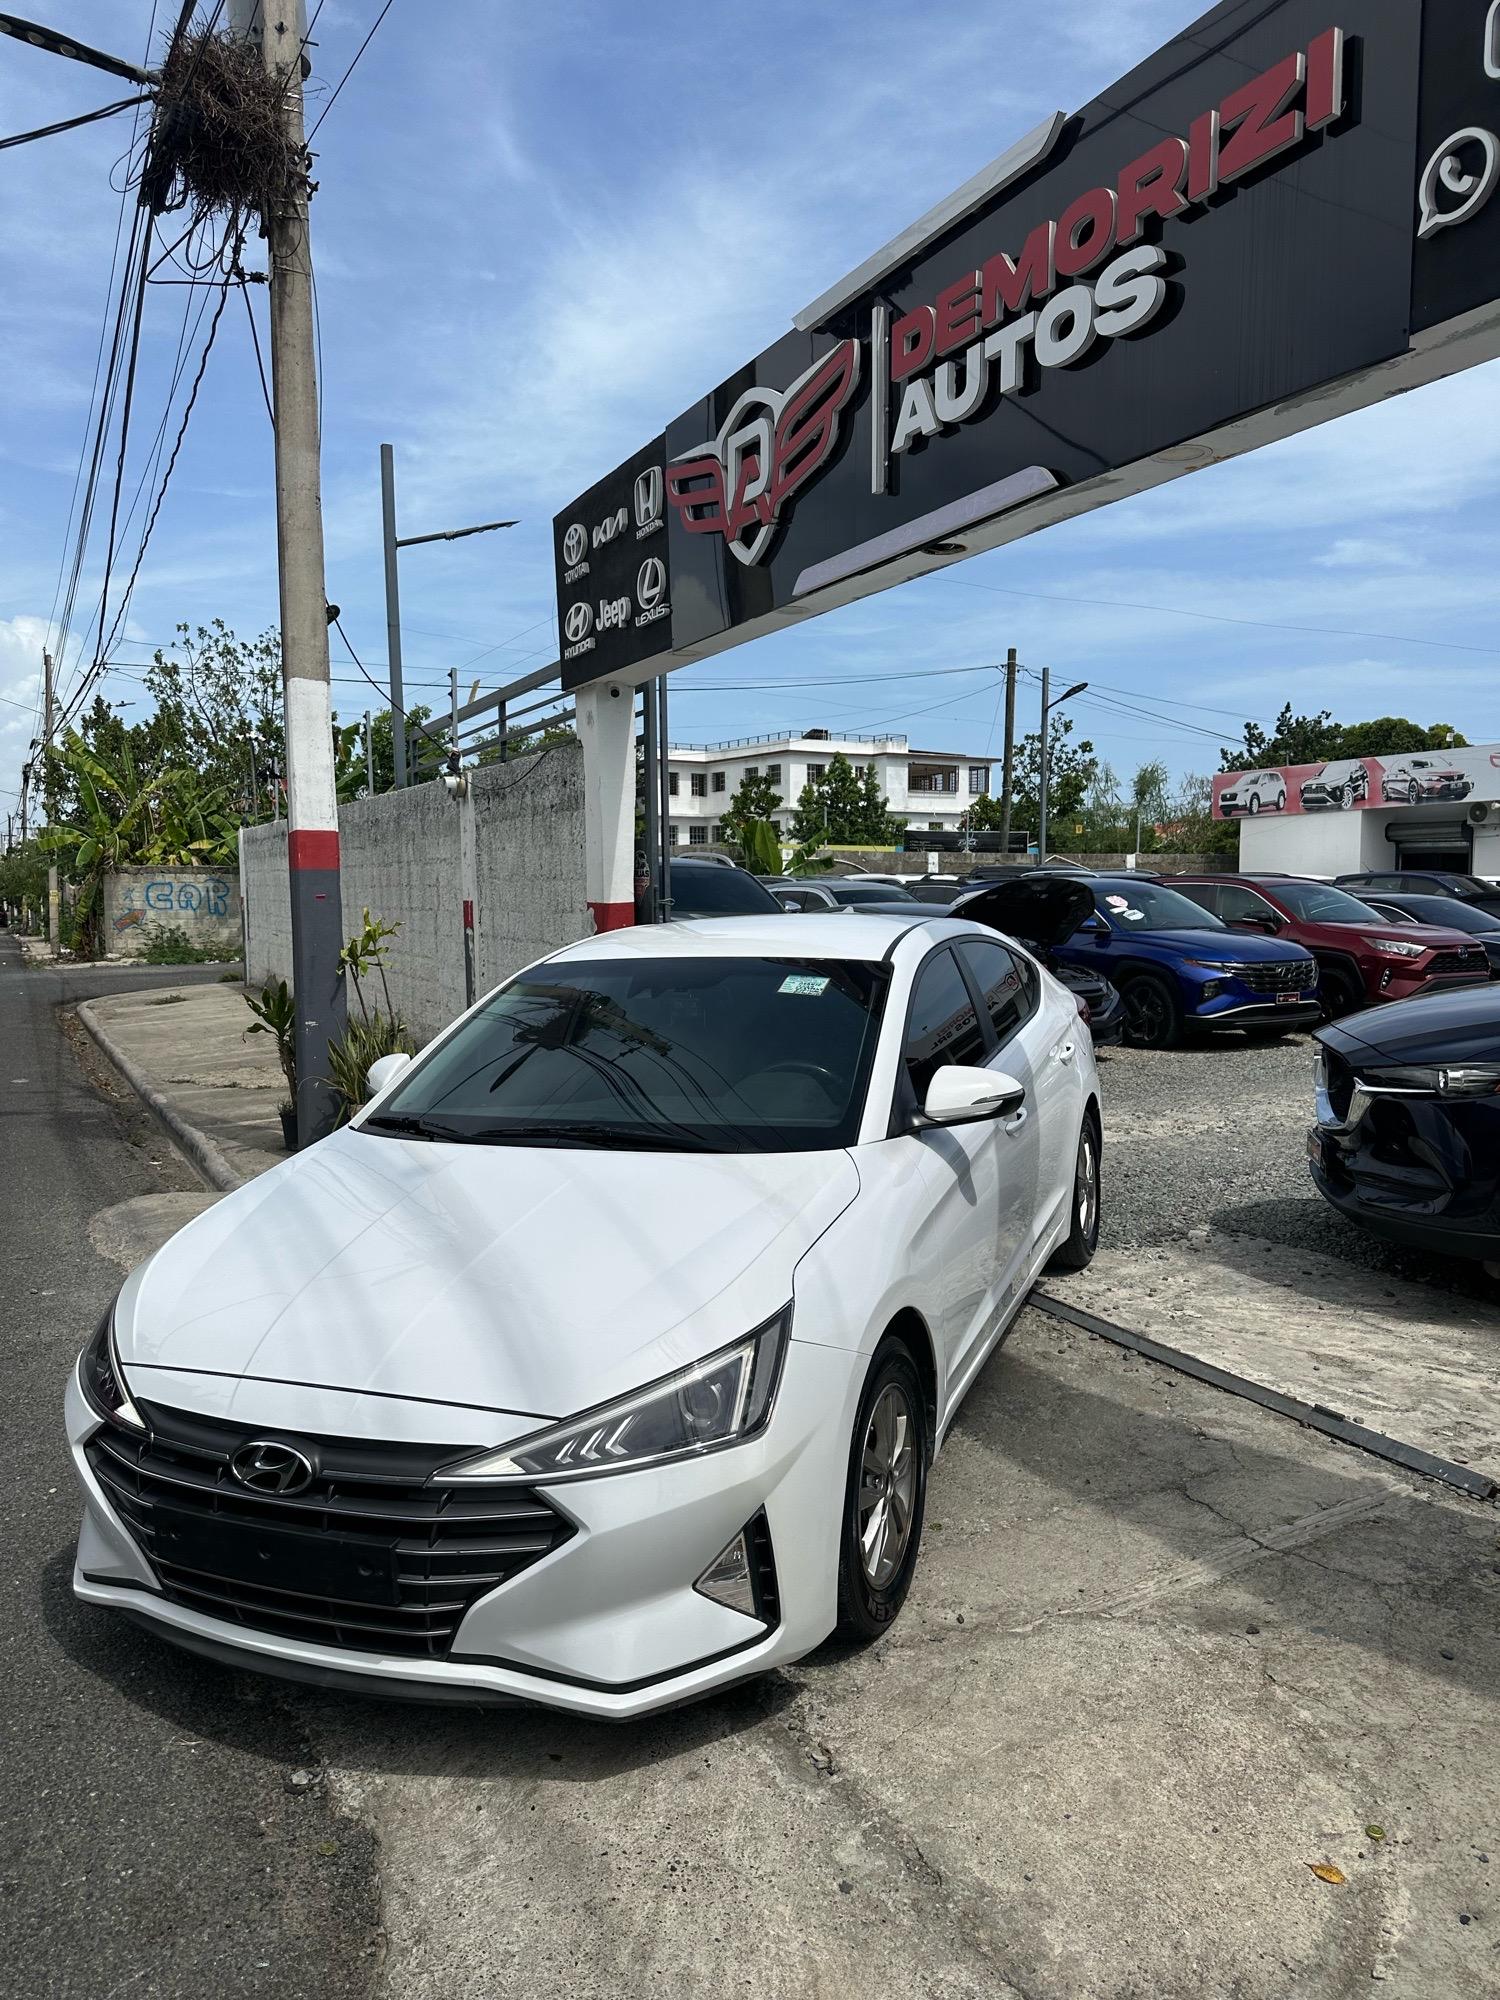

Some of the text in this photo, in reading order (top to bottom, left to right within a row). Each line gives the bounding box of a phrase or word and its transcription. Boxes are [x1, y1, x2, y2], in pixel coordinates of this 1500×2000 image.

[891, 26, 1343, 382] DEMORIZI
[890, 244, 1167, 453] AUTOS
[636, 519, 664, 540] HONDA
[564, 561, 590, 585] TOYOTA
[595, 596, 632, 631] Jeep
[635, 603, 670, 627] LEXUS
